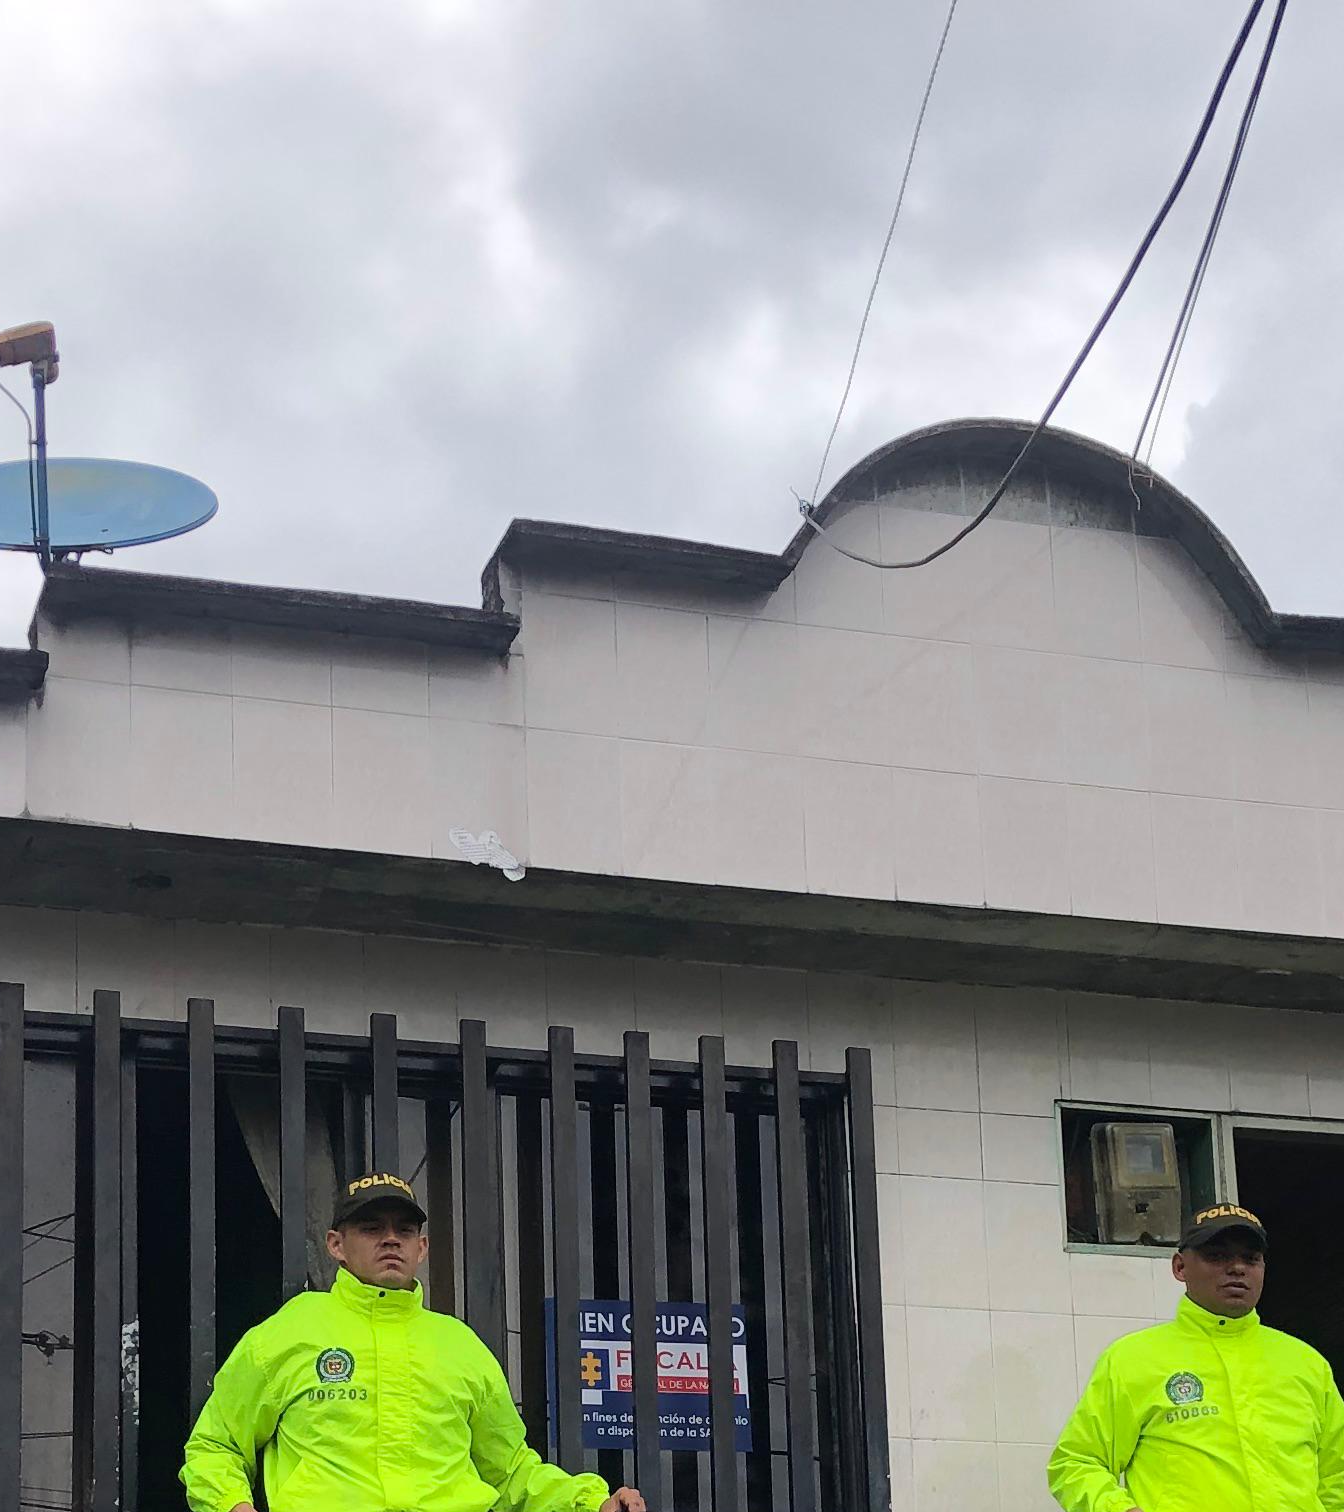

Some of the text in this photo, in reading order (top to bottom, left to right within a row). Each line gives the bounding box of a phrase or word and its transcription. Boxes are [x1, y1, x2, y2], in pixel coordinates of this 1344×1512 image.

[579, 1311, 615, 1333] IEN
[669, 1380, 683, 1389] DE
[688, 1414, 703, 1425] de
[597, 1427, 605, 1435] a
[669, 1426, 685, 1437] de
[686, 1427, 697, 1437] la
